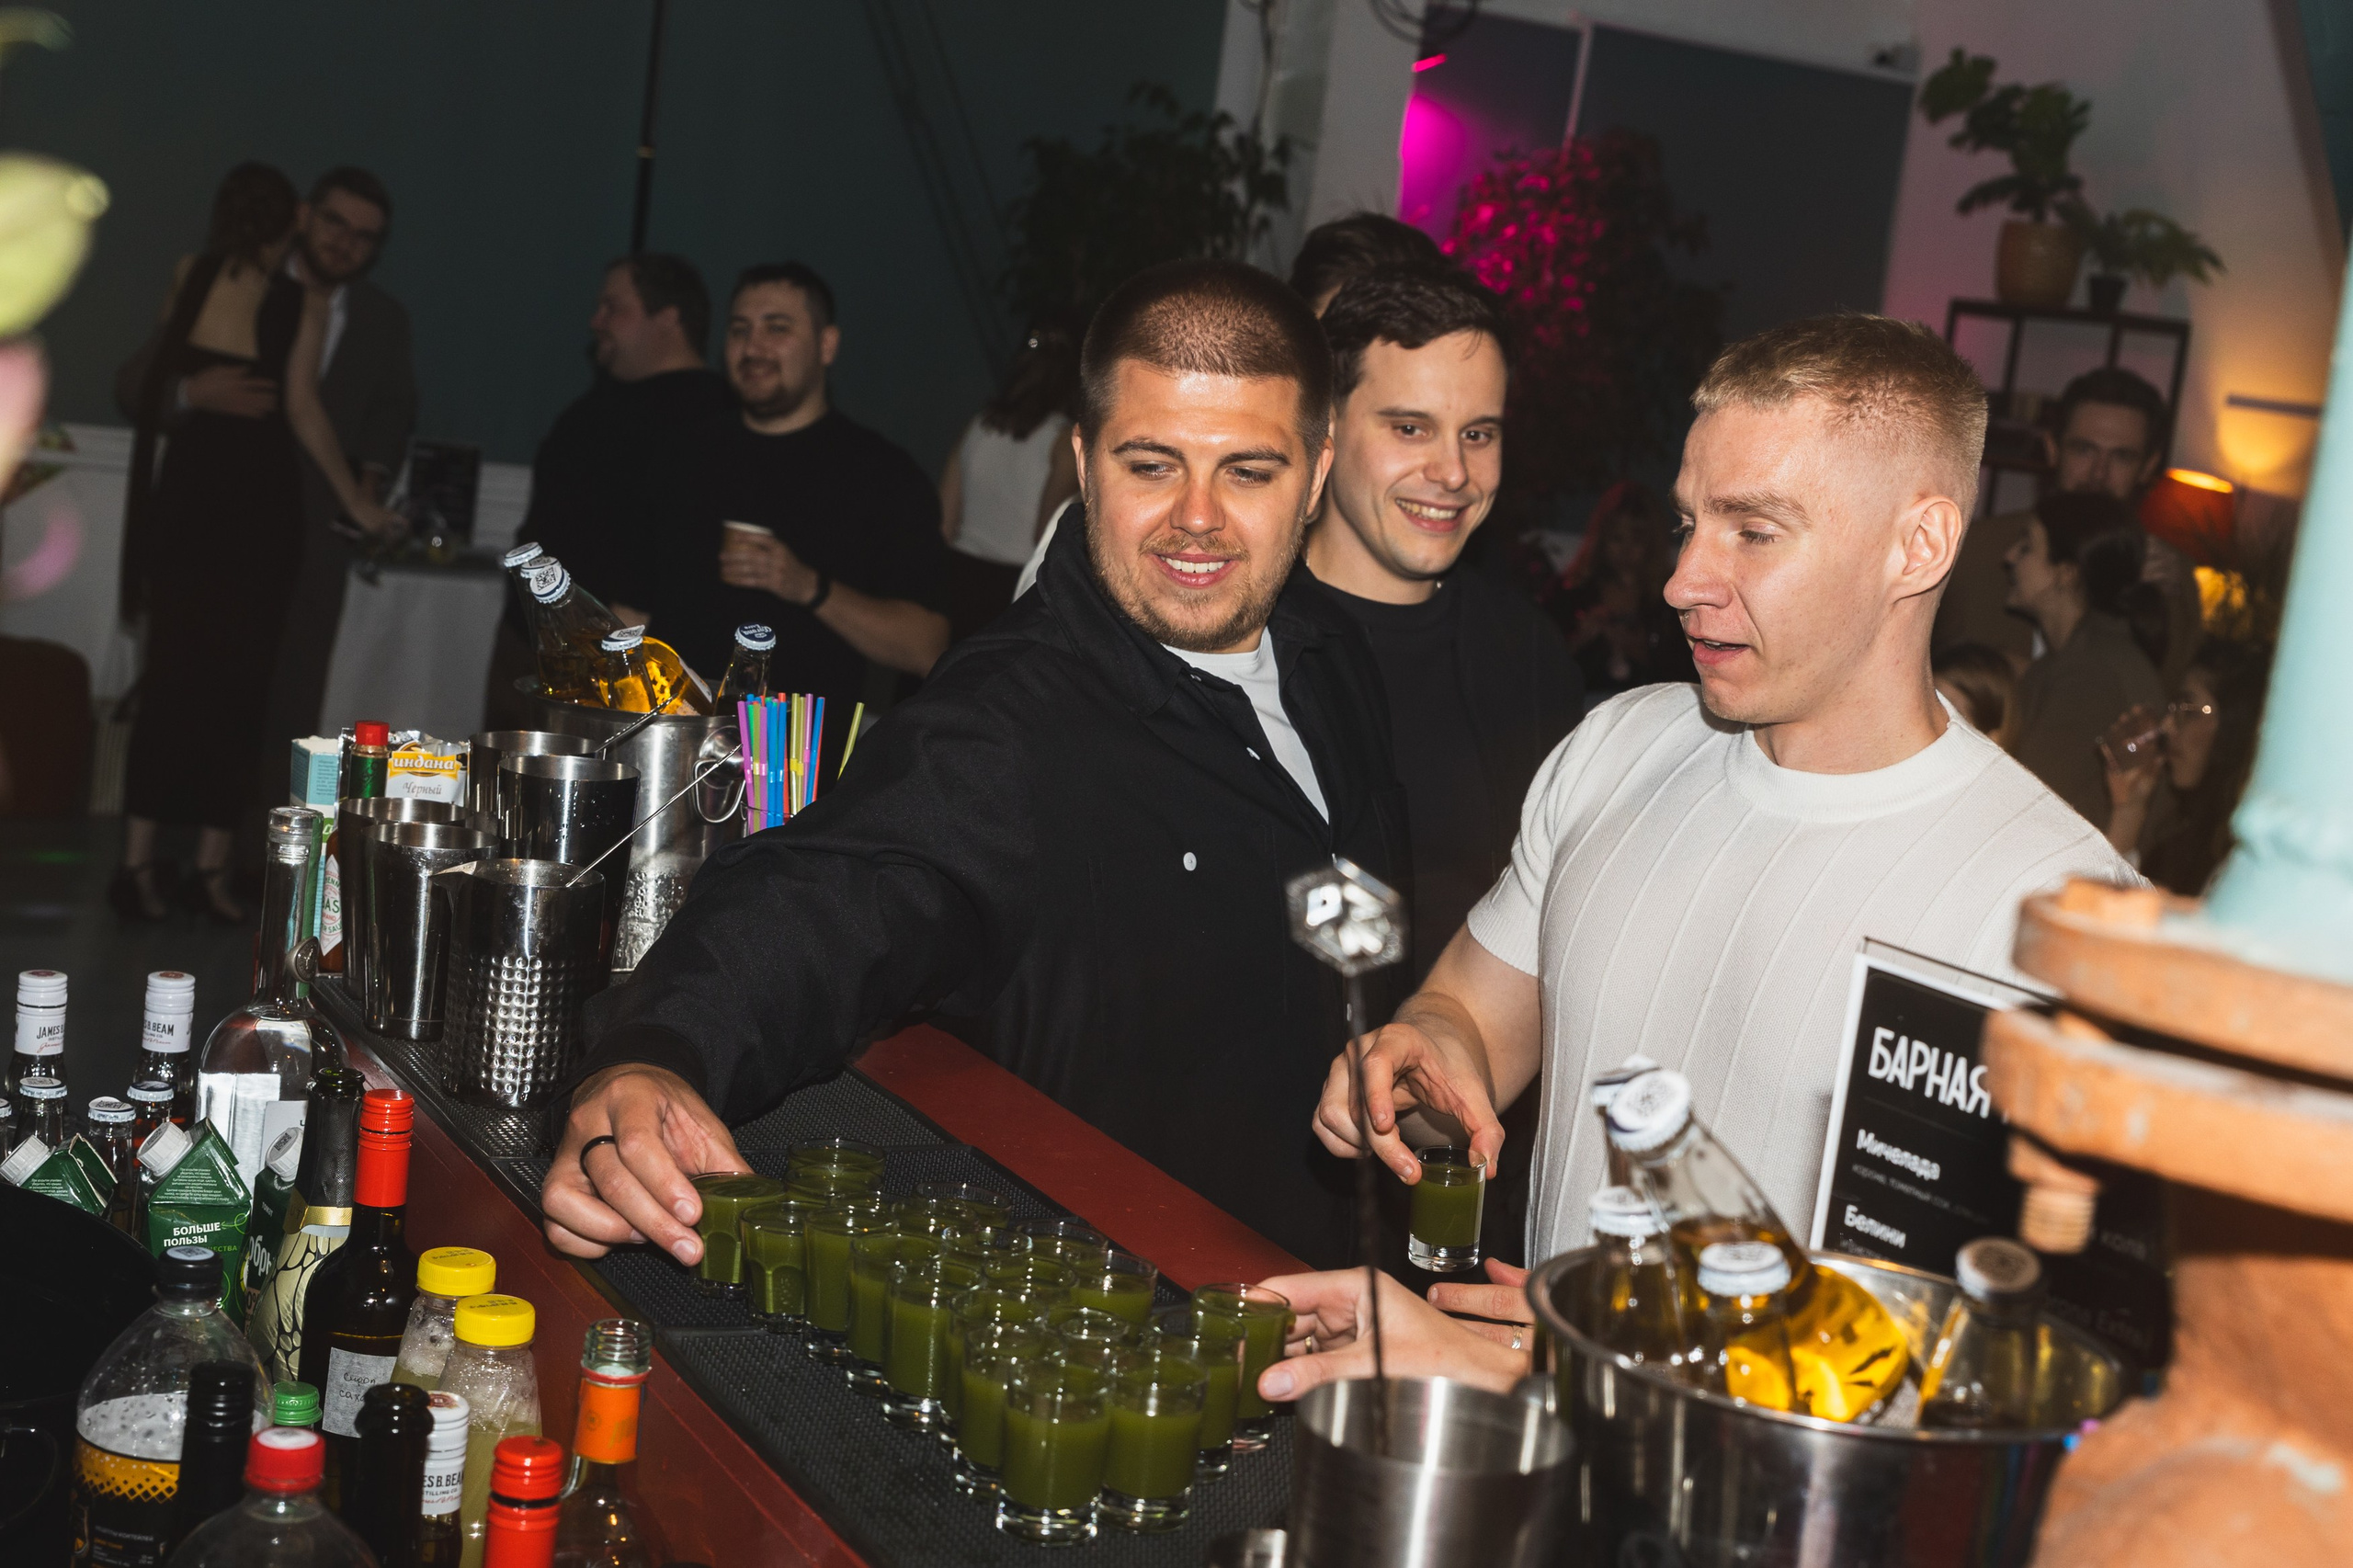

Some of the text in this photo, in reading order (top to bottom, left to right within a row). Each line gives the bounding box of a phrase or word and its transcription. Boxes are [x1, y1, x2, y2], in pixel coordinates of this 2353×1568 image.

[393, 755, 455, 770] индана
[403, 781, 442, 797] Черный
[36, 1025, 61, 1040] JAMES
[1868, 1026, 1992, 1119] БАРНАЯ
[173, 1221, 222, 1236] БОЛЬШЕ
[164, 1234, 208, 1247] ПОЛЬЗЫ
[445, 1471, 463, 1487] BEA
